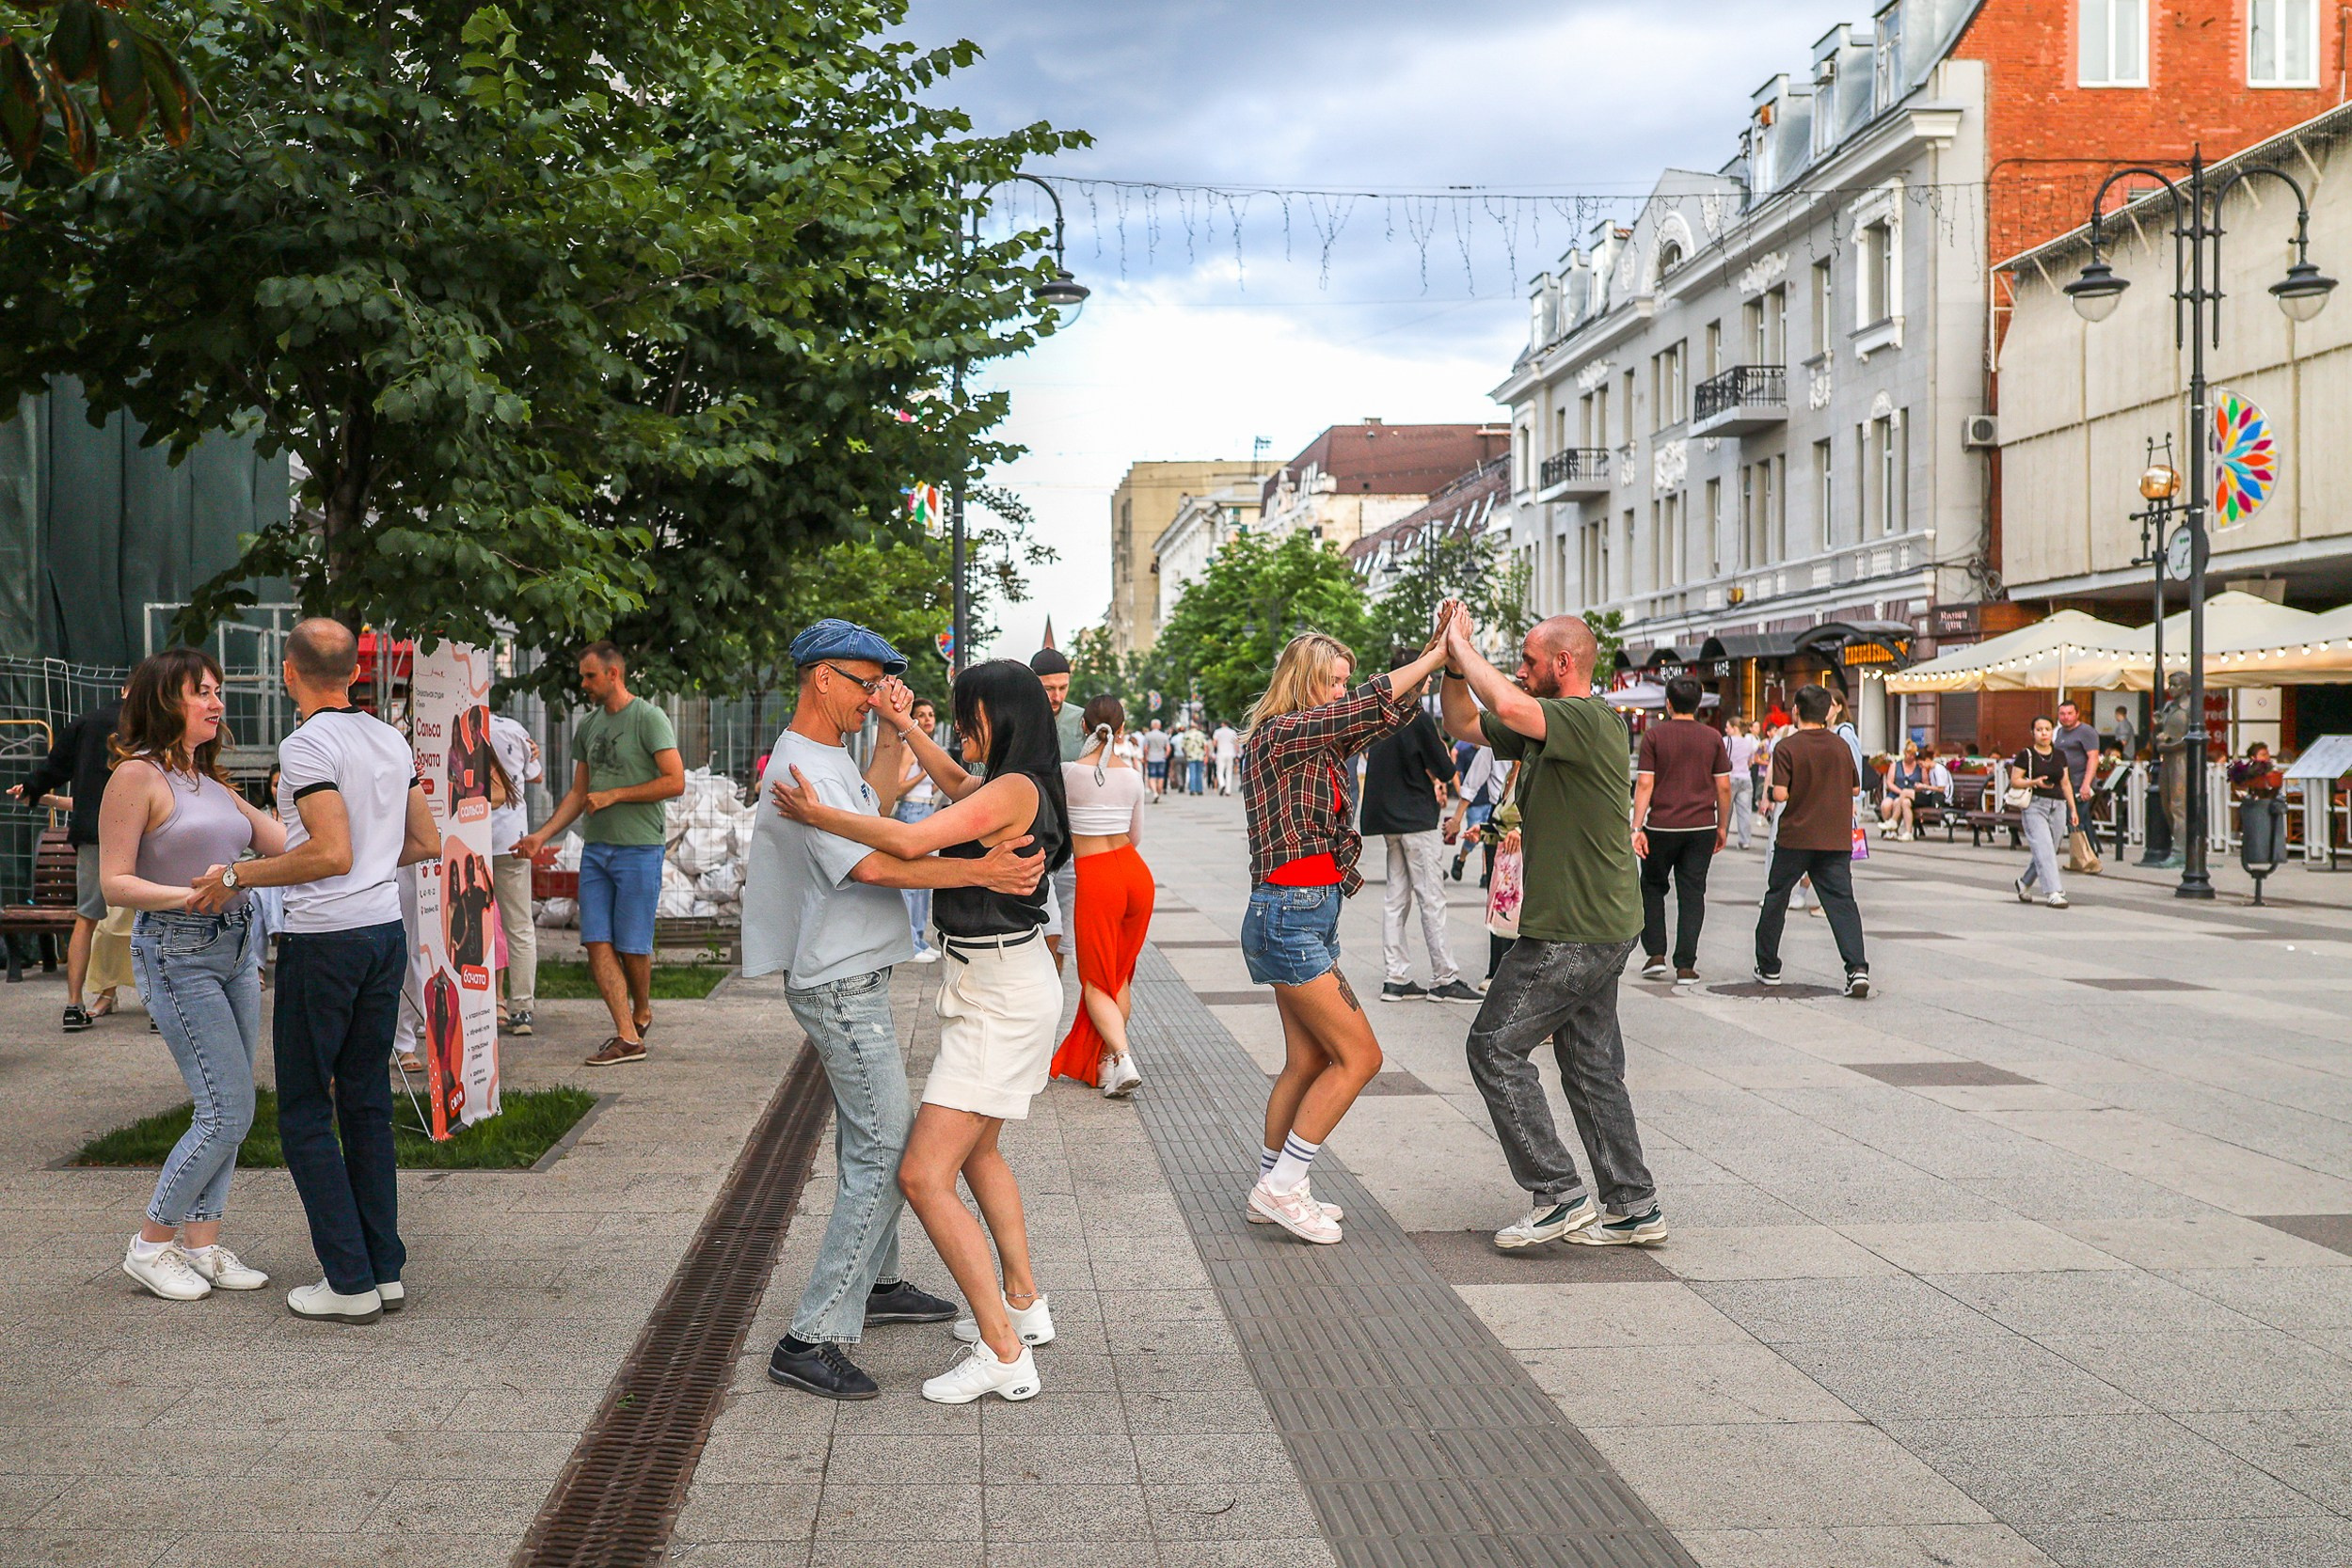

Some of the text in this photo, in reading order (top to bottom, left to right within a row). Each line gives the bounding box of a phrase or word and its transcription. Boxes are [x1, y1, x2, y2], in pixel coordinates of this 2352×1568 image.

[416, 717, 441, 737] Сальса
[416, 748, 440, 768] Бачата
[461, 803, 485, 817] сальса
[464, 969, 485, 985] бачата
[451, 1090, 463, 1110] соло
